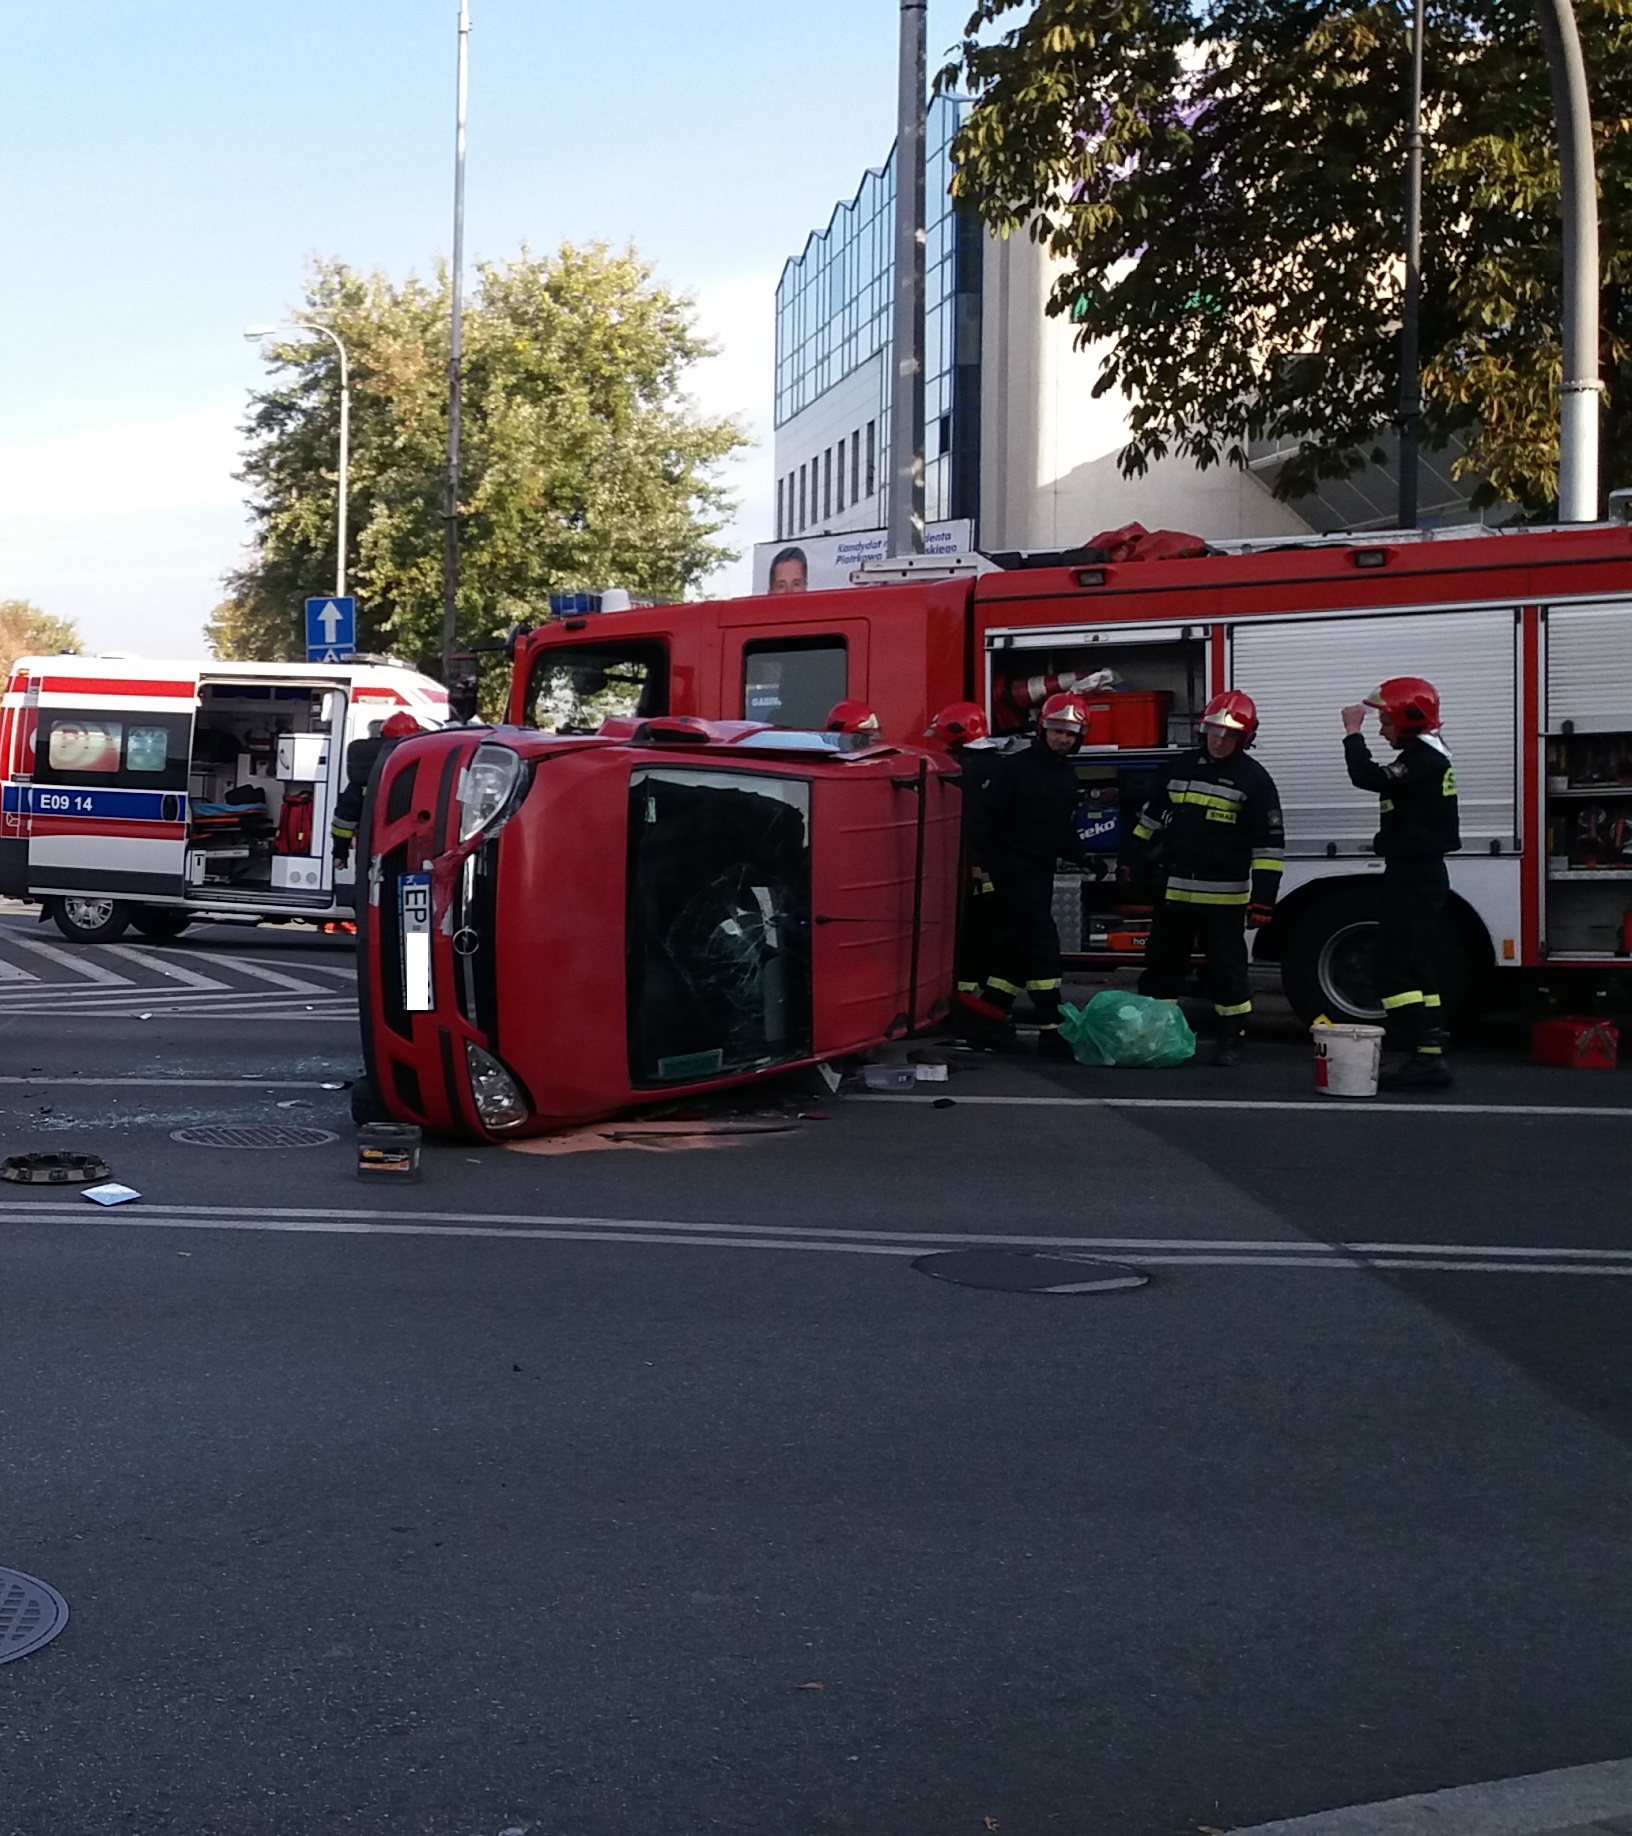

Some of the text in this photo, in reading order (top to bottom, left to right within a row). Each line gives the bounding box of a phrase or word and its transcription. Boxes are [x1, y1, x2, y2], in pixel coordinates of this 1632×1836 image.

[837, 540, 882, 553] Kandydat
[835, 553, 882, 565] Piotrkowa
[40, 793, 93, 811] E09 14
[405, 889, 427, 923] EP
